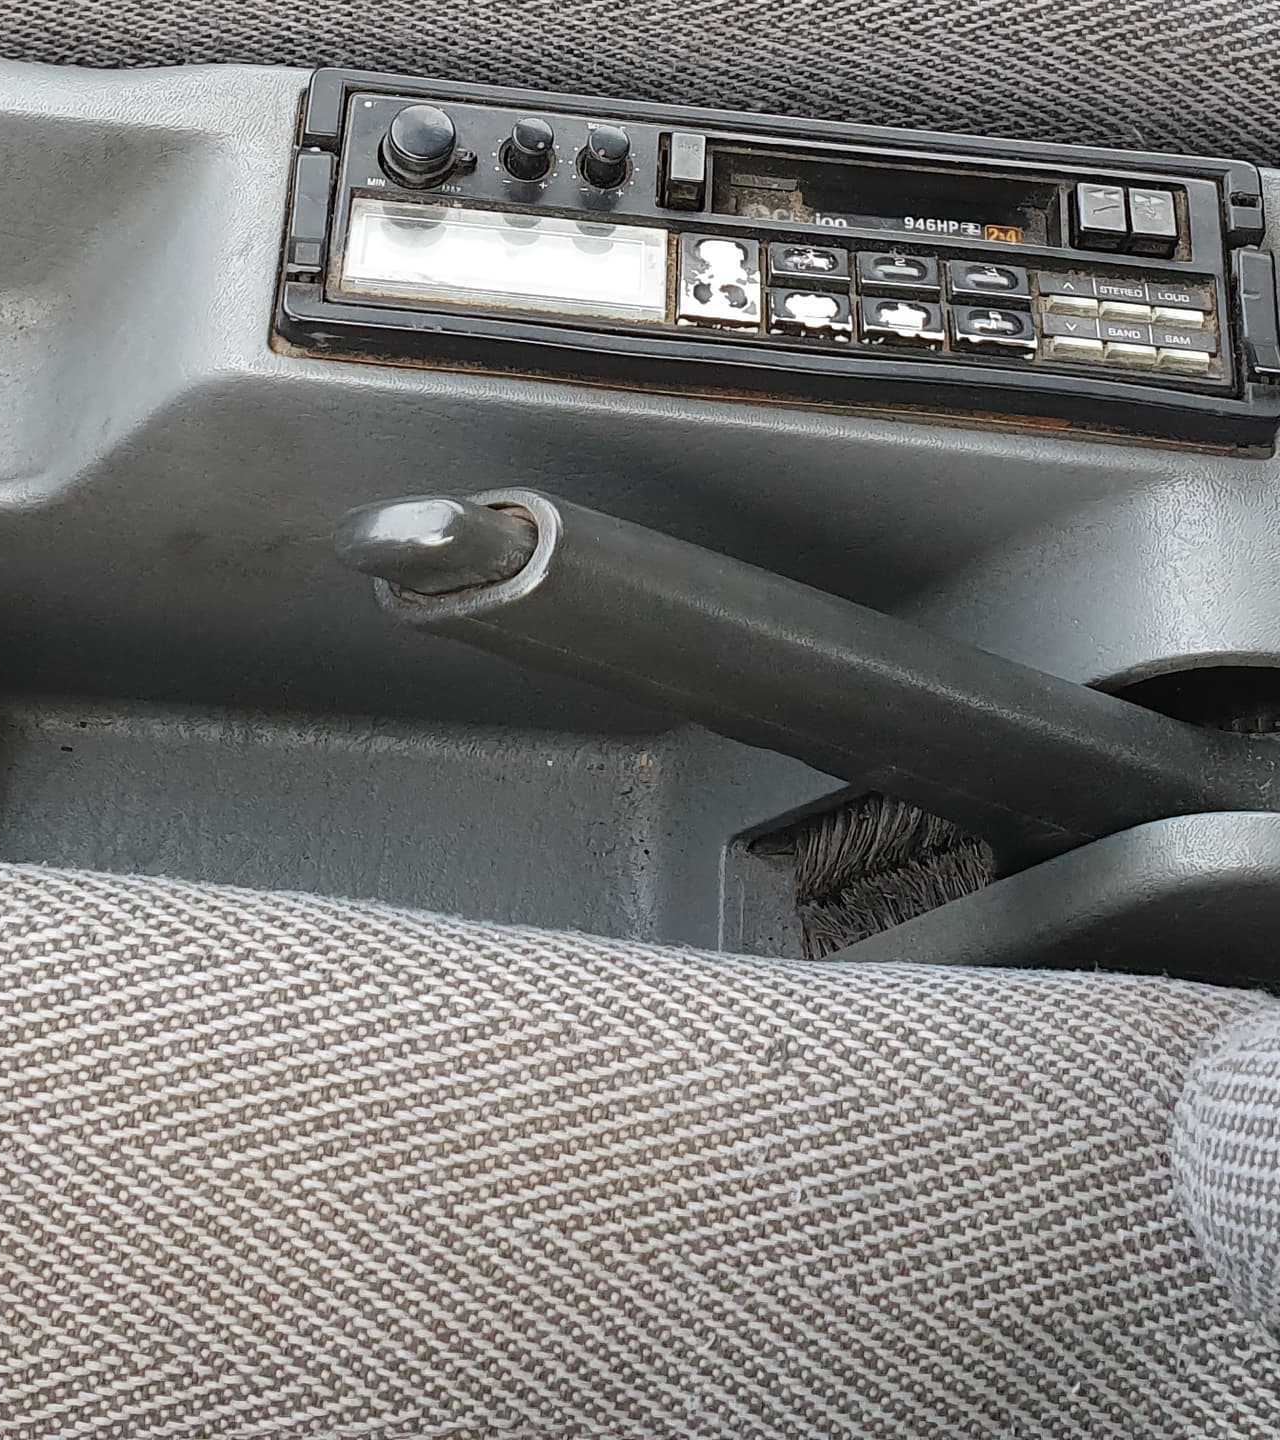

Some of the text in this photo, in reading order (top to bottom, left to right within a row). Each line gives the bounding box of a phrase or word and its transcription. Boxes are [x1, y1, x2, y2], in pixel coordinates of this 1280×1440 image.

[367, 177, 386, 187] MIN
[904, 216, 959, 234] 946HP
[1099, 285, 1144, 298] STEREO
[1157, 292, 1191, 303] LOUD
[1107, 327, 1141, 339] BAND
